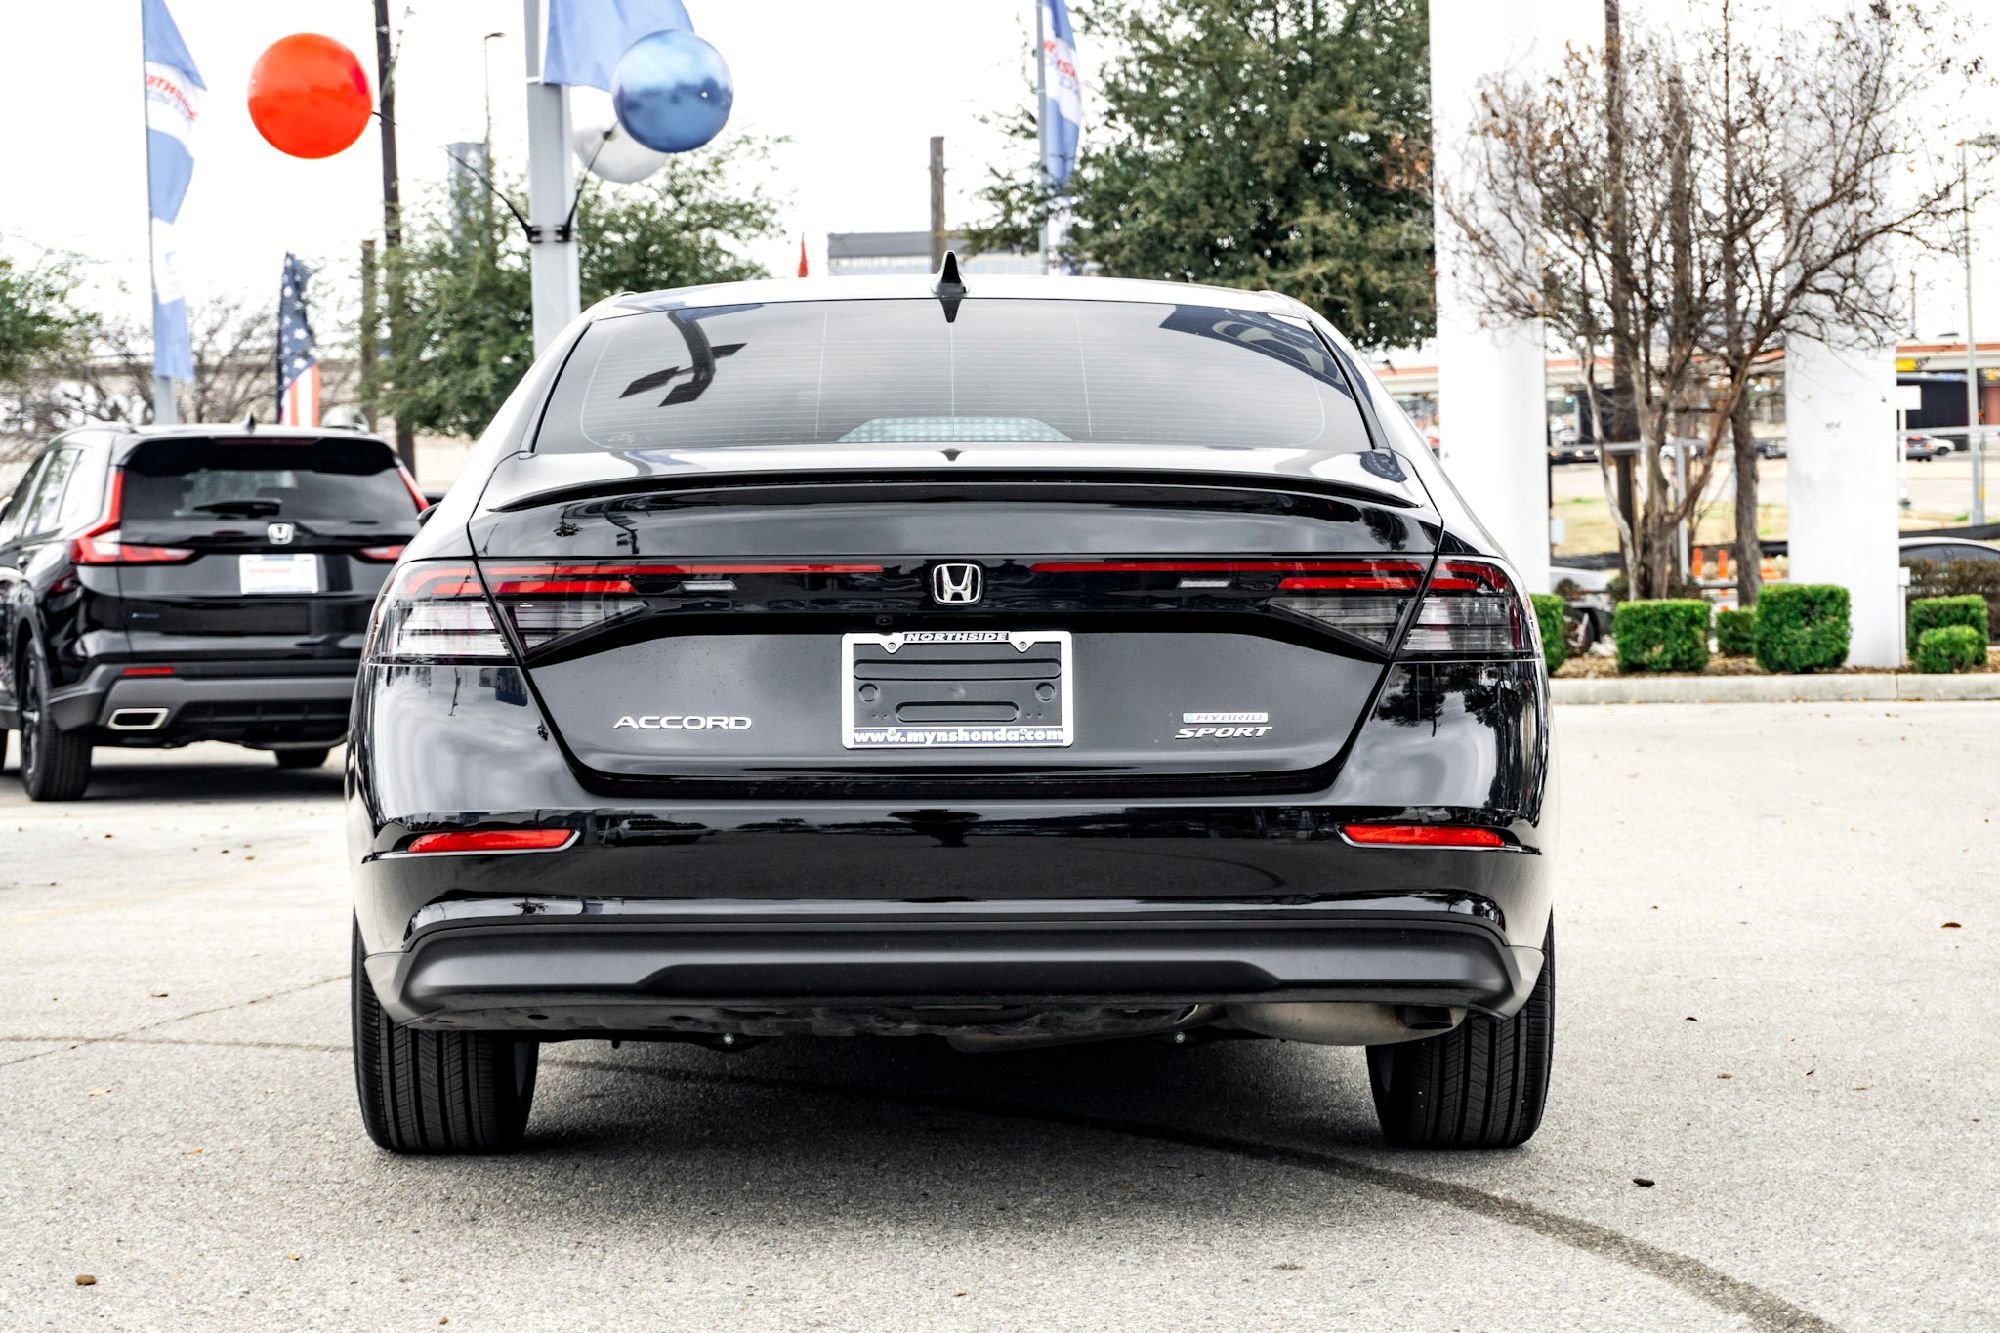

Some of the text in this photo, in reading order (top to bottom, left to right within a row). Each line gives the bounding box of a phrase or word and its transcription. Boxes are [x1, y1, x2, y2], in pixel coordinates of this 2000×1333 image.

[905, 632, 1008, 642] NORTHSIDE
[612, 715, 753, 730] ACCORD
[1196, 714, 1264, 722] HYBRID
[854, 728, 1064, 745] www.mynshonda.com
[1174, 726, 1273, 739] SPORT
